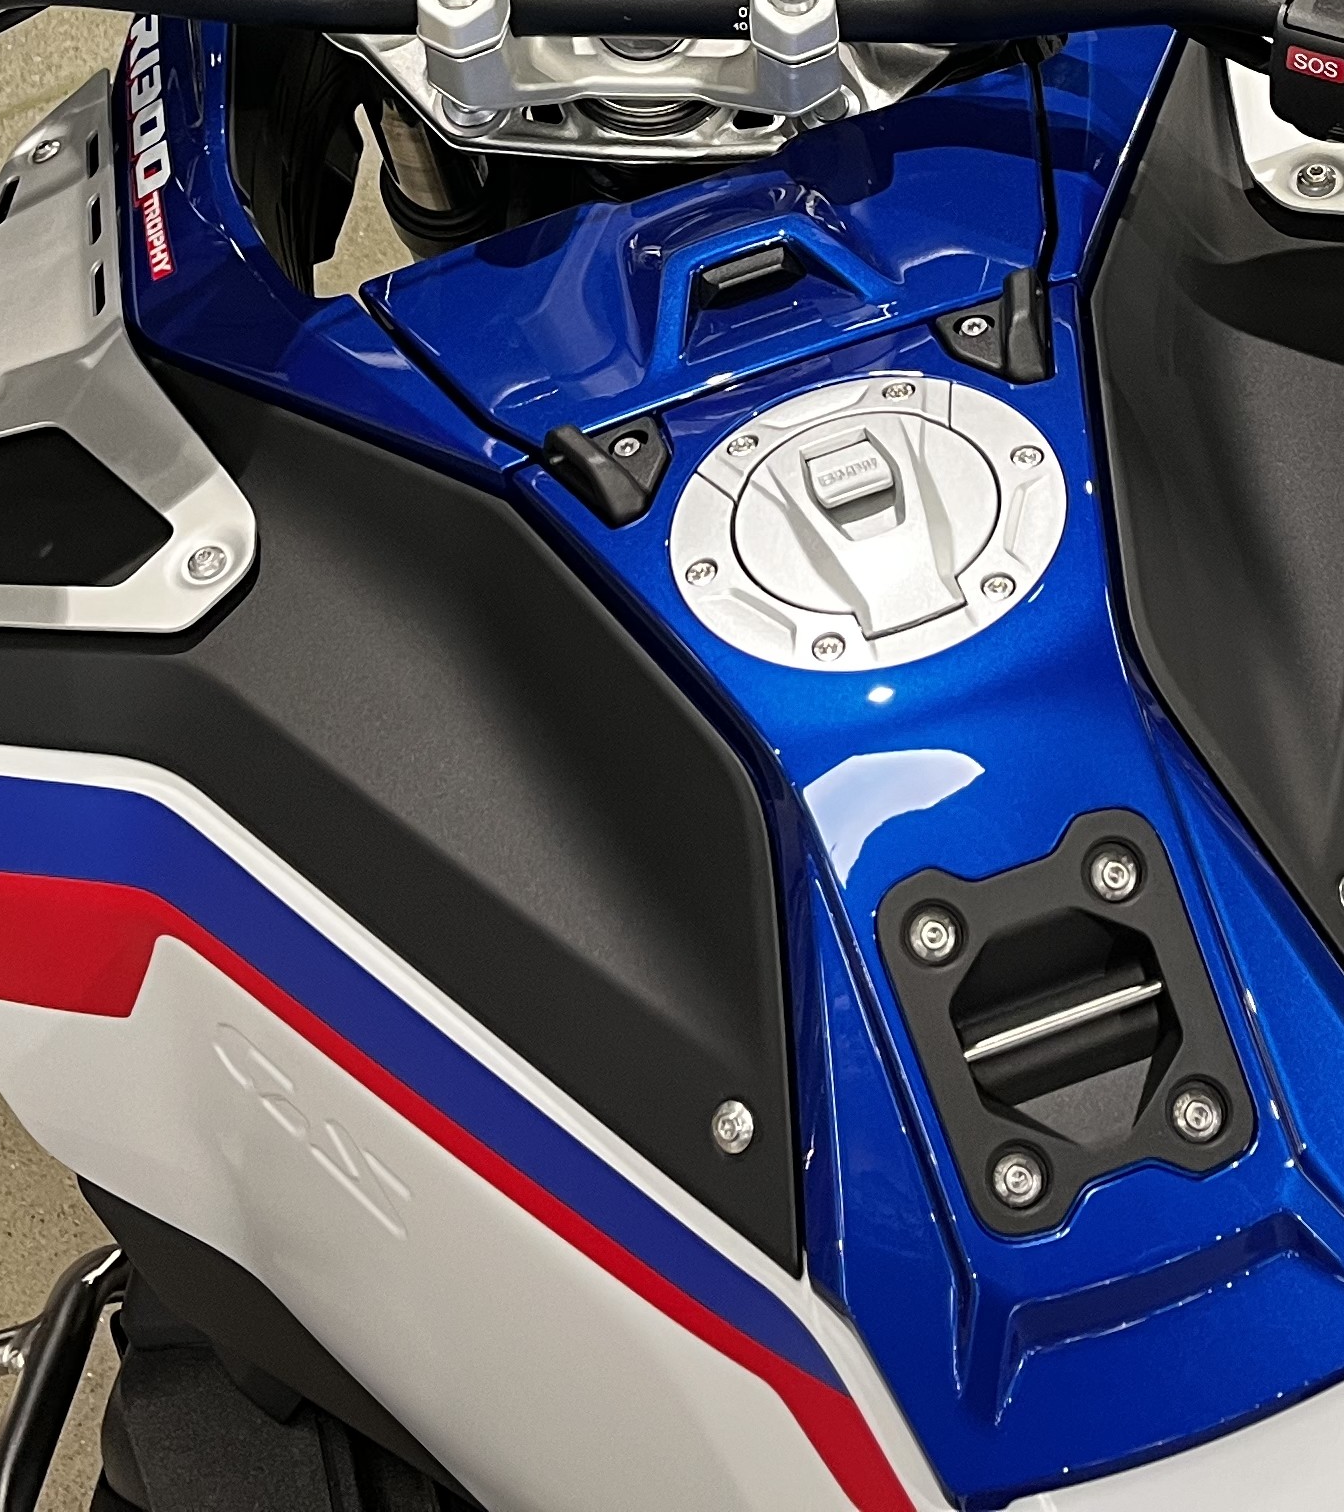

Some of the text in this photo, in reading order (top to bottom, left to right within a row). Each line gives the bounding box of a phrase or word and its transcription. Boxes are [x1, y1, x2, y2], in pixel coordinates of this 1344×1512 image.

[1293, 52, 1338, 78] SOS
[143, 190, 172, 275] TROPHY
[818, 457, 879, 487] BMW
